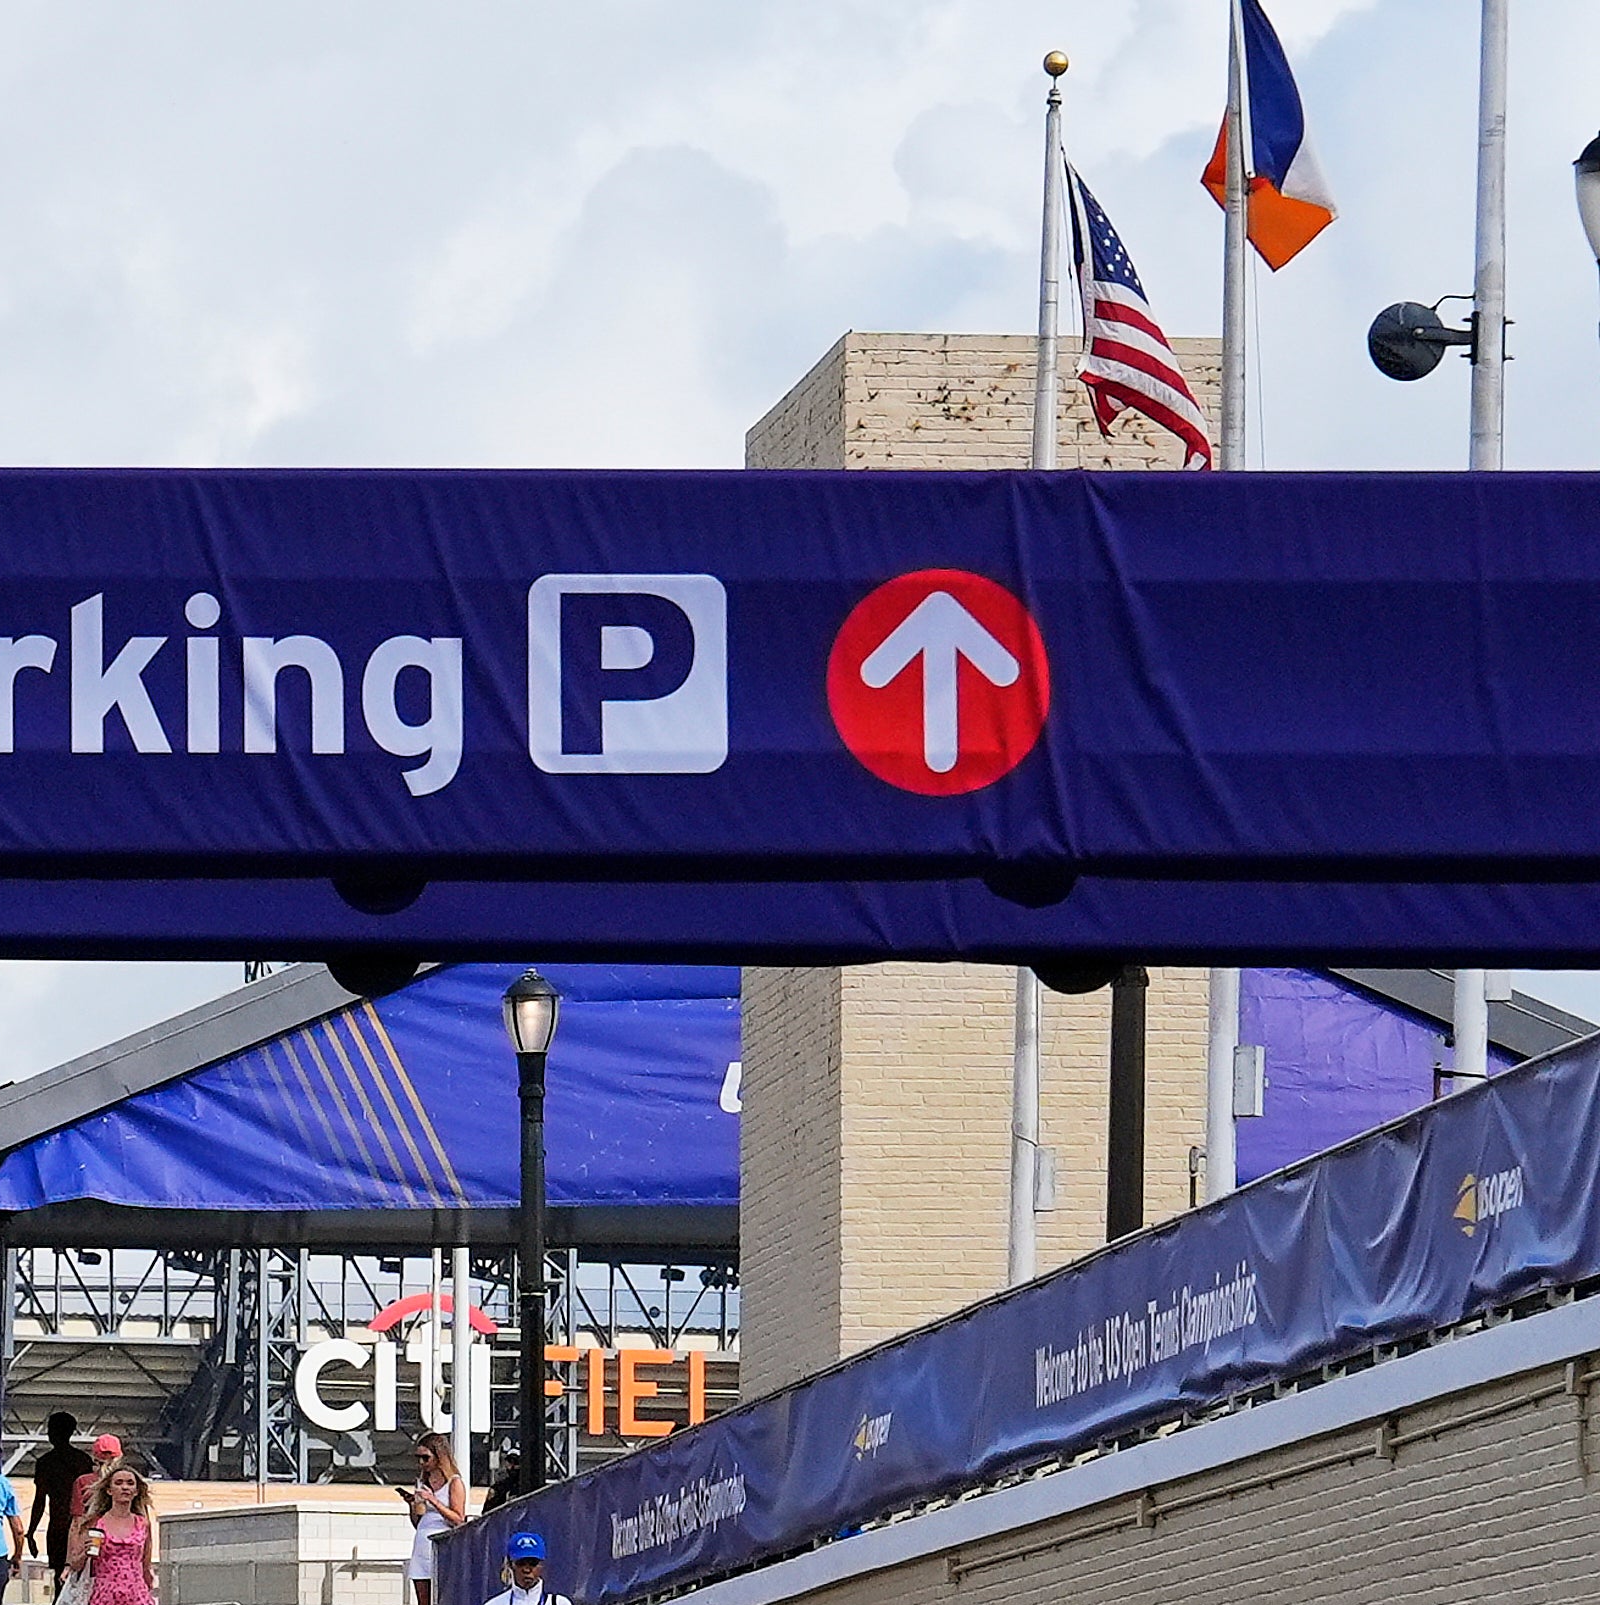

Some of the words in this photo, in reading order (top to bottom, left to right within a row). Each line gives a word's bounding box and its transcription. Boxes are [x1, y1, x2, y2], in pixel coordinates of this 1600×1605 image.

[1036, 1343, 1075, 1408] Welcome
[1105, 1315, 1121, 1381] US
[1122, 1311, 1146, 1388] Open
[1148, 1290, 1180, 1364] Tennis
[1181, 1259, 1257, 1357] Championships
